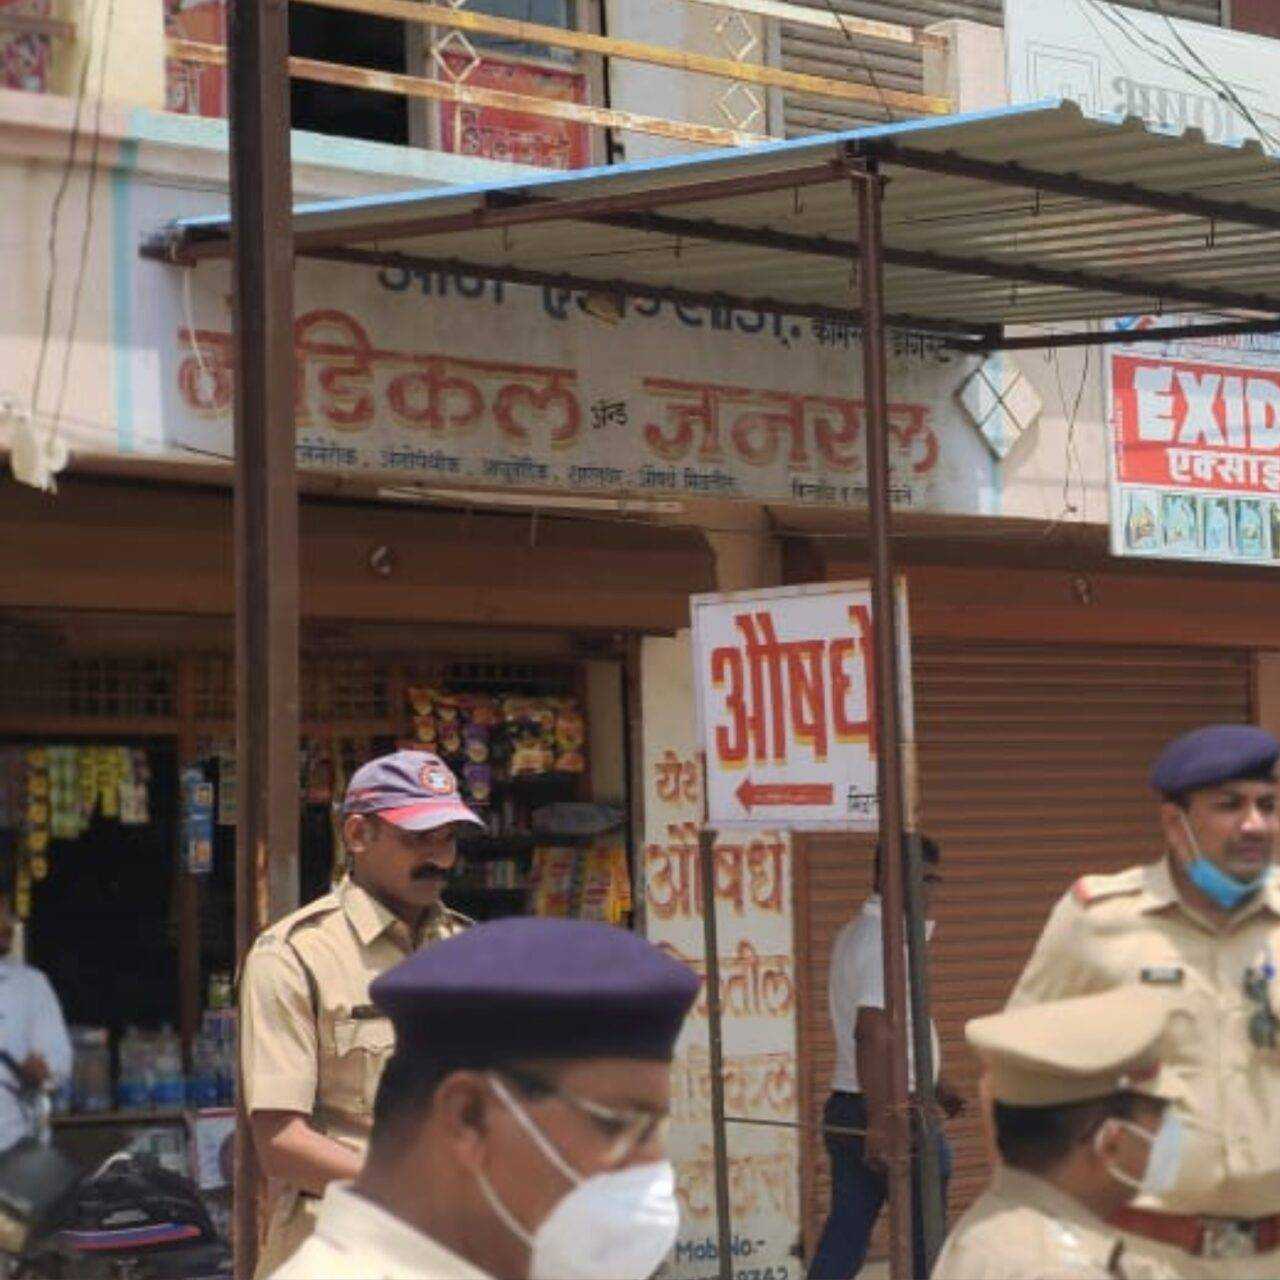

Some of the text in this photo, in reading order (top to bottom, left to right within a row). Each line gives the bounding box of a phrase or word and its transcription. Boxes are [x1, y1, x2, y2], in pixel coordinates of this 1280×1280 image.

[178, 308, 583, 445] मडिकल
[711, 604, 880, 766] औषधे
[654, 750, 702, 801] येथ
